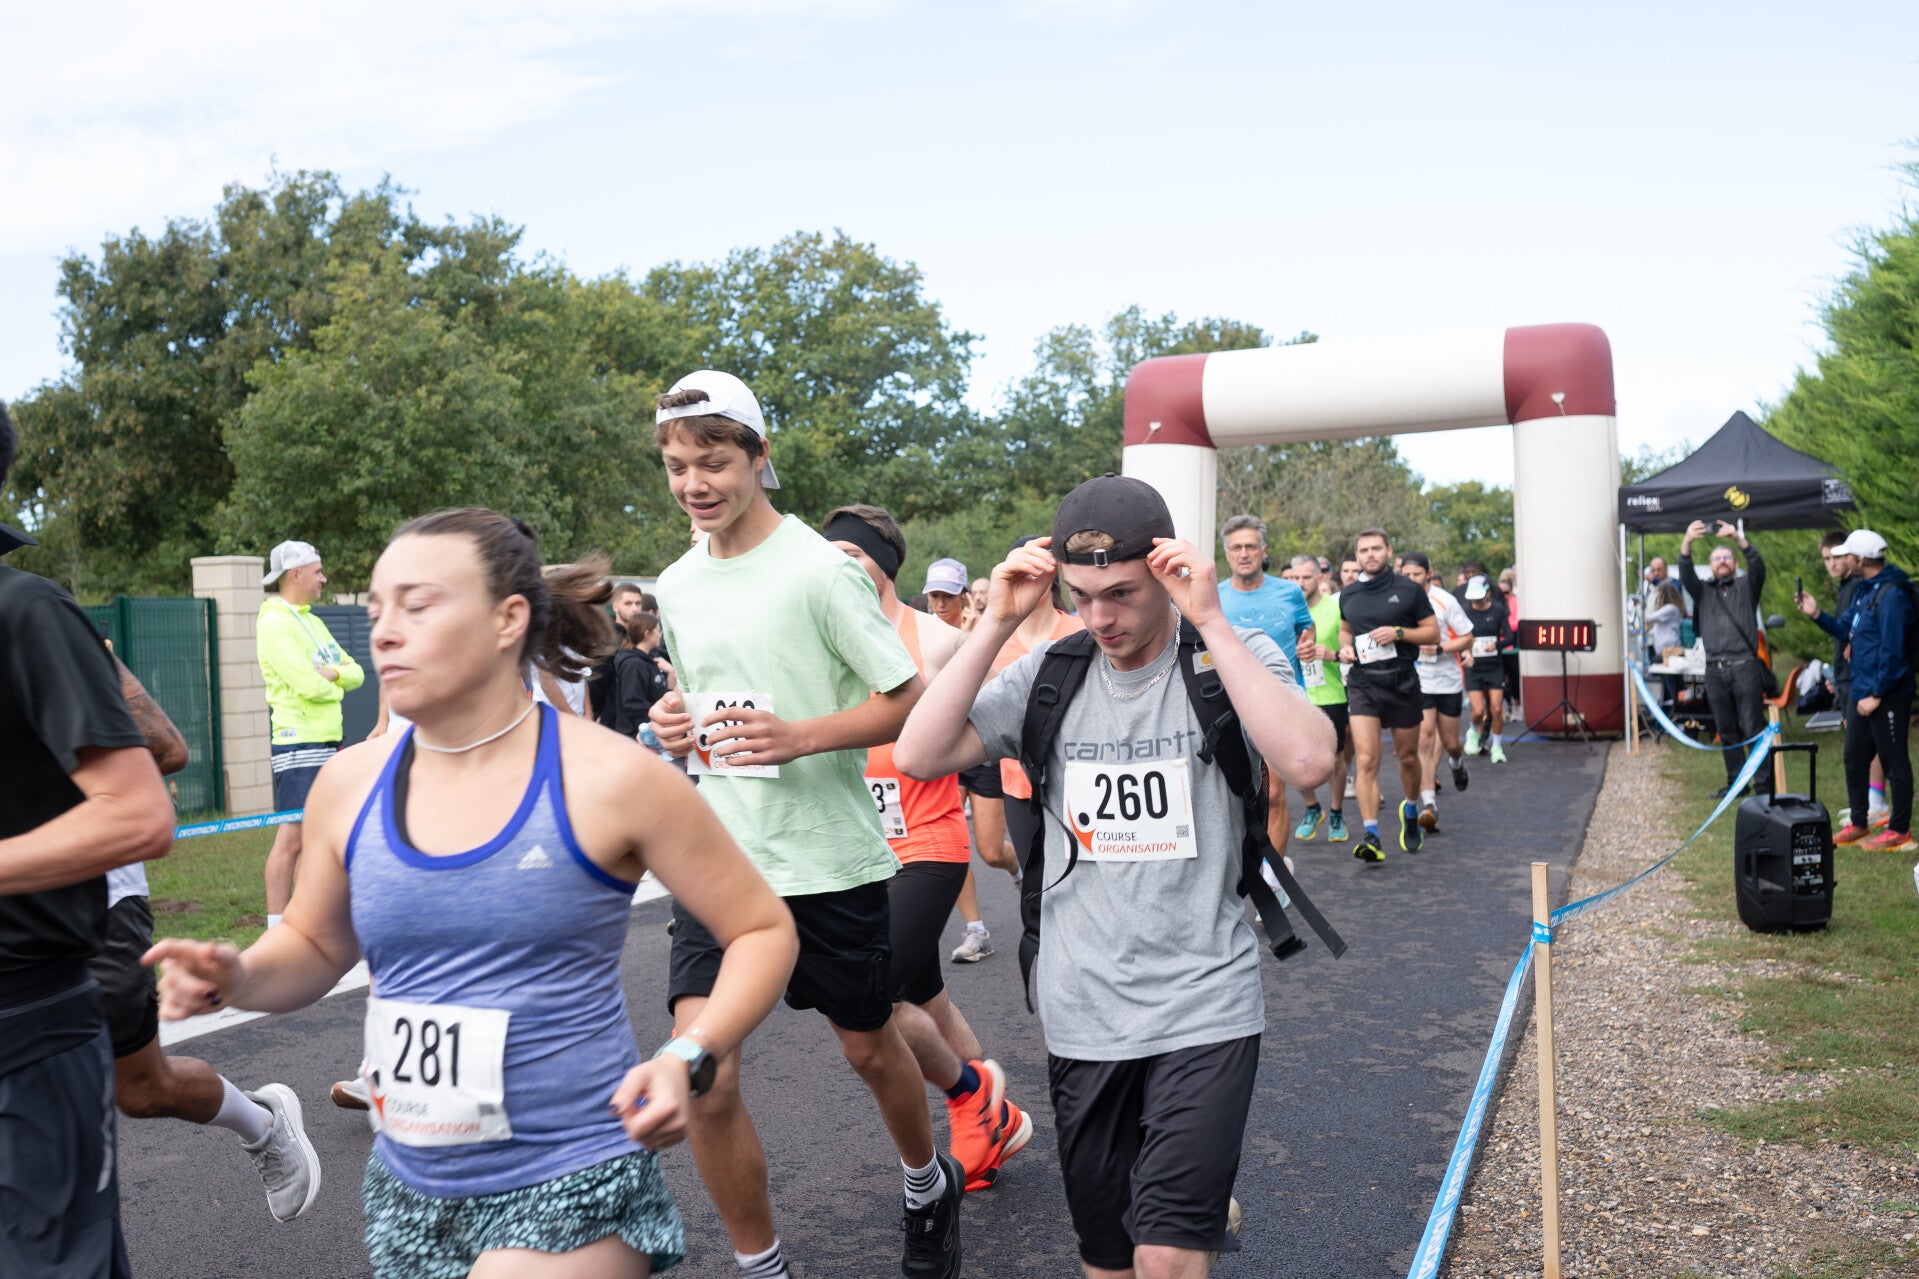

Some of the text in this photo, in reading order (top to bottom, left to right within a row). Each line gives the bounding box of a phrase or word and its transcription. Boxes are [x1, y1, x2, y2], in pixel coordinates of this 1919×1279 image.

[1094, 771, 1169, 821] 260
[1096, 831, 1138, 842] COURSE
[1098, 841, 1177, 854] ORGANISATION
[393, 1017, 462, 1087] 281
